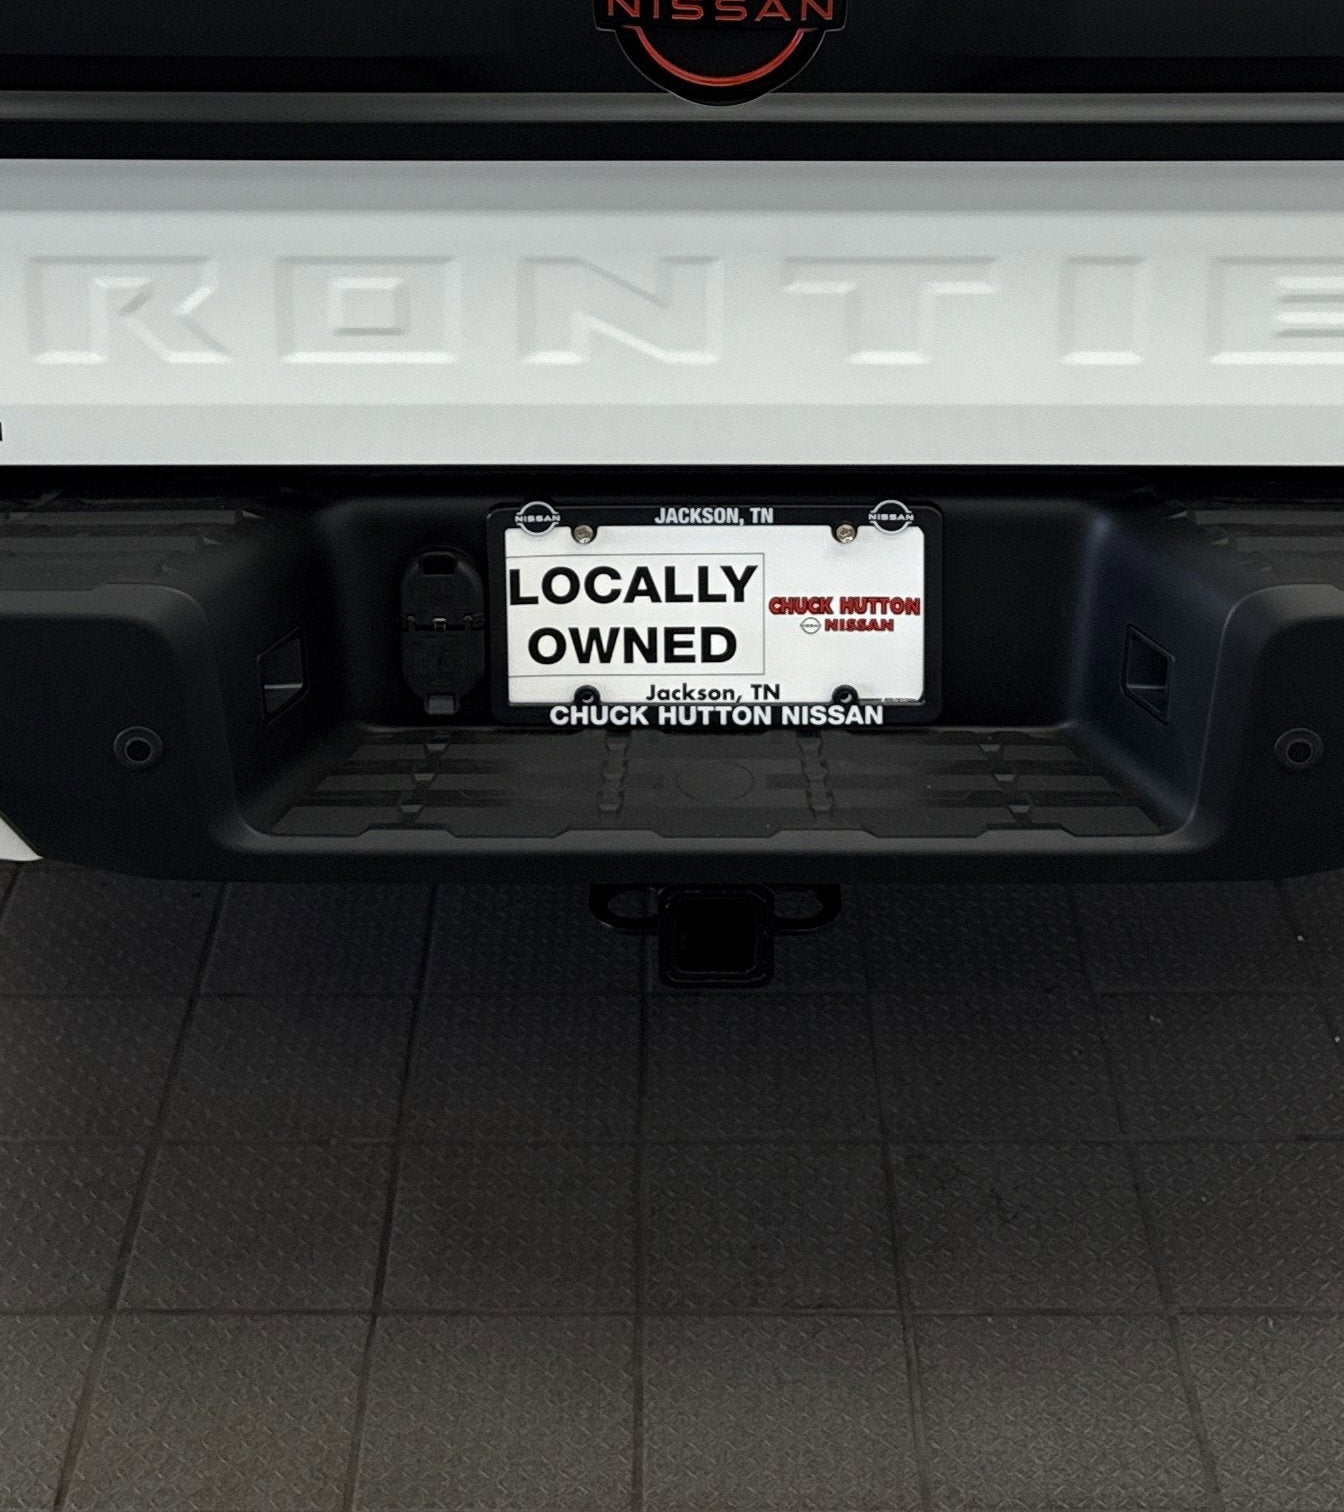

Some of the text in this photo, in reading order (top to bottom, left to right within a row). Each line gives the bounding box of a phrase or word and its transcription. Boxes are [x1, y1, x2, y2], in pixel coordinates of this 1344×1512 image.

[514, 514, 561, 523] NISSAN
[654, 507, 774, 526] JACKSON, TN
[867, 513, 915, 522] NISSAN
[508, 564, 759, 606] LOCALLY
[768, 596, 921, 616] CHUCK HUTTON
[824, 618, 895, 632] NISSAN
[527, 626, 738, 665] OWNED
[645, 683, 781, 704] Jackson, TN
[549, 705, 884, 726] CHUCK HUTTON NISSAN
